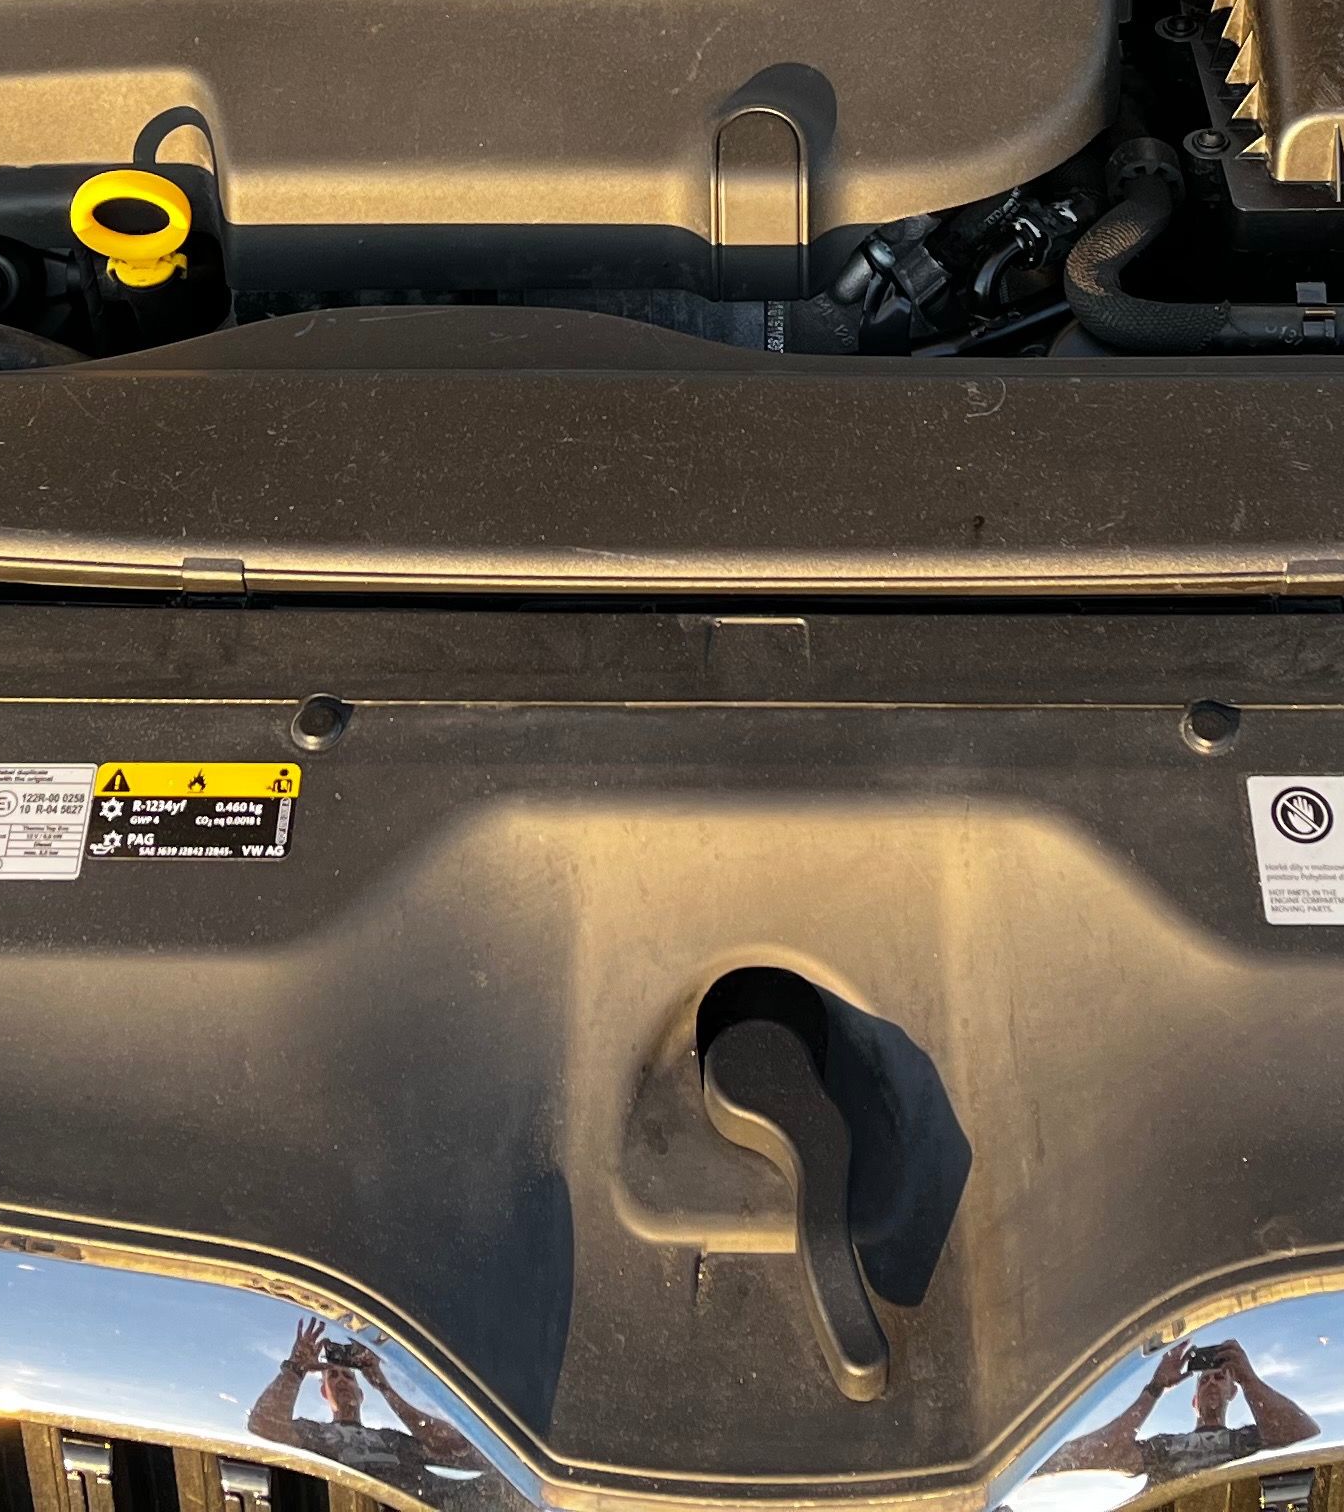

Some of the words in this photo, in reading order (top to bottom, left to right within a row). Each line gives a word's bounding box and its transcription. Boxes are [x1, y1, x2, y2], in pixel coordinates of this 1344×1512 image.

[22, 793, 60, 803] 122R-00
[20, 805, 32, 814] 10
[36, 805, 58, 814] R-04
[132, 800, 187, 813] R-1234yf
[215, 802, 247, 813] 0.460
[248, 802, 264, 814] kg
[130, 816, 152, 825] GWP
[153, 816, 160, 825] 4
[214, 817, 225, 827] eq
[127, 833, 155, 846] PAG
[139, 847, 155, 856] SAE
[241, 845, 264, 856] VW
[265, 845, 285, 856] AG
